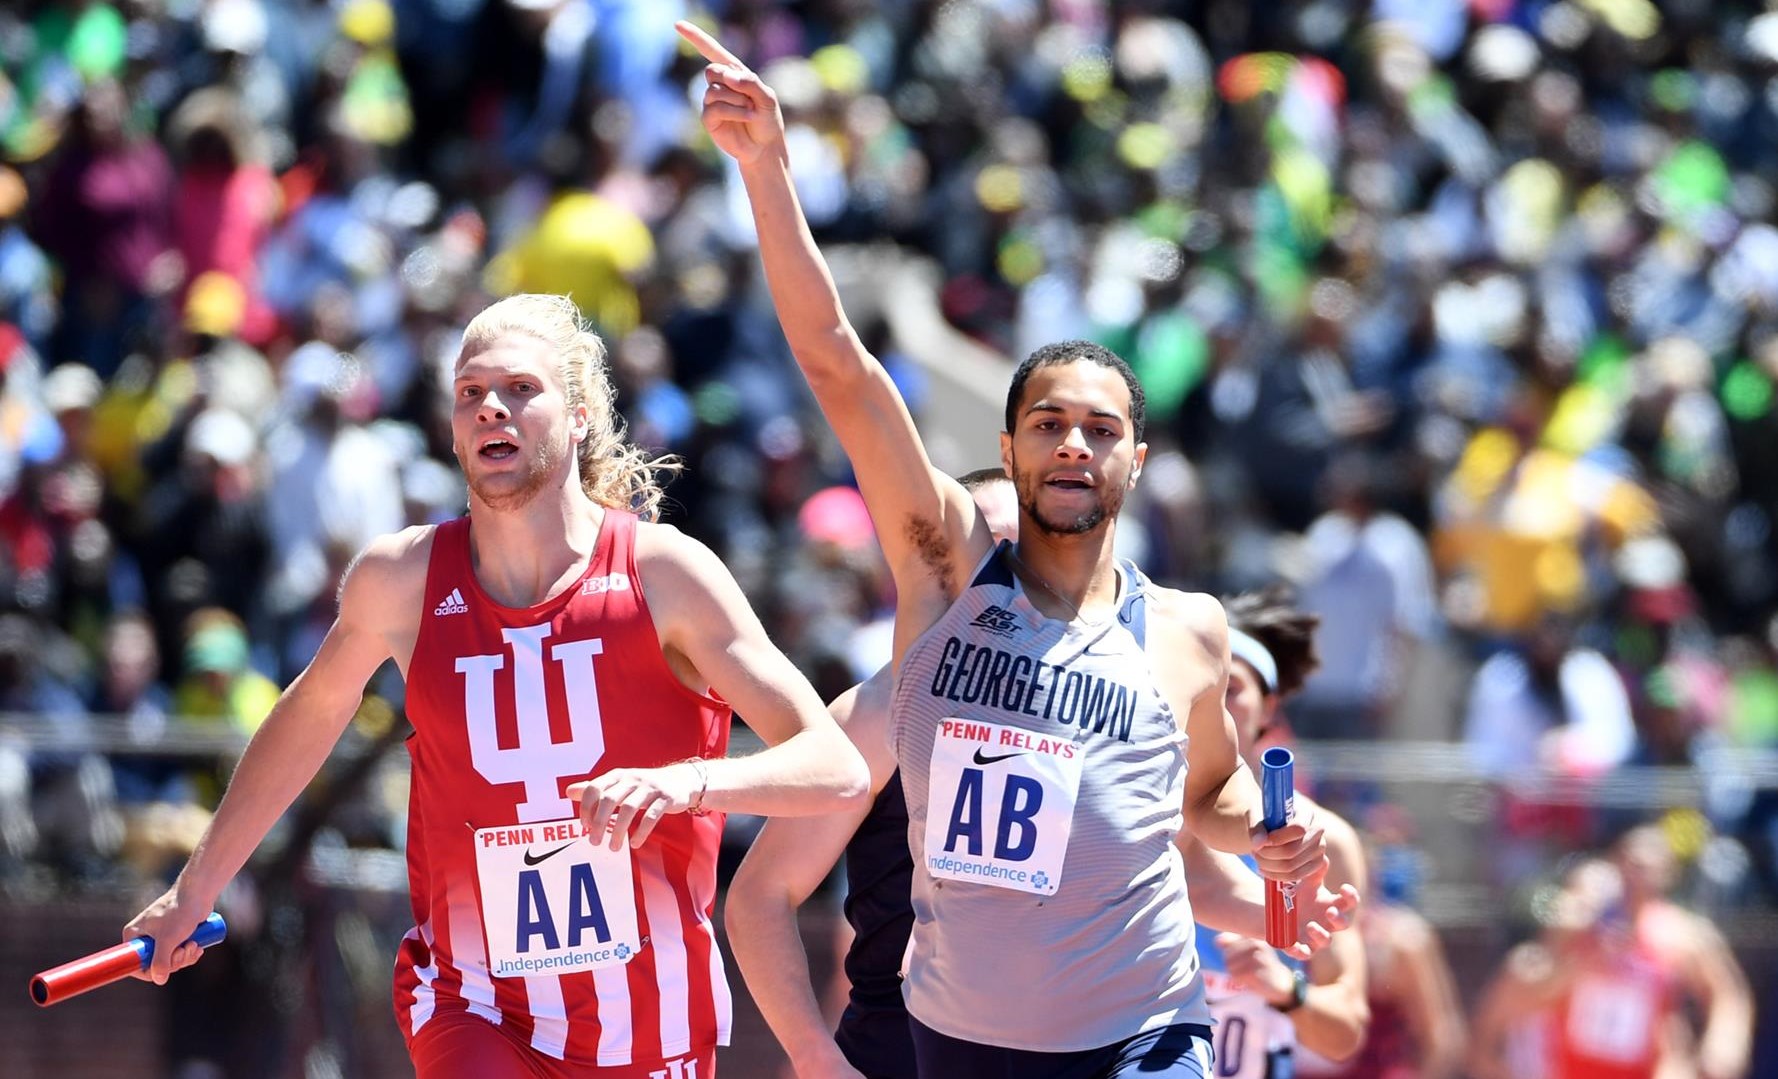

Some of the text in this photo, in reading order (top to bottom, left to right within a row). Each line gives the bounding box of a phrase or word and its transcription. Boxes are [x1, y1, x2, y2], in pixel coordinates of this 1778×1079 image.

[434, 604, 469, 616] adidas
[974, 613, 1022, 632] EAST
[984, 605, 1018, 621] BIG
[930, 637, 1138, 743] GEORGETOWN
[942, 720, 1074, 759] PENN RELAYS
[943, 767, 1044, 862] AB
[483, 828, 535, 848] PENN
[928, 854, 1027, 882] Independence
[516, 862, 612, 954] AA
[500, 949, 611, 972] Independence
